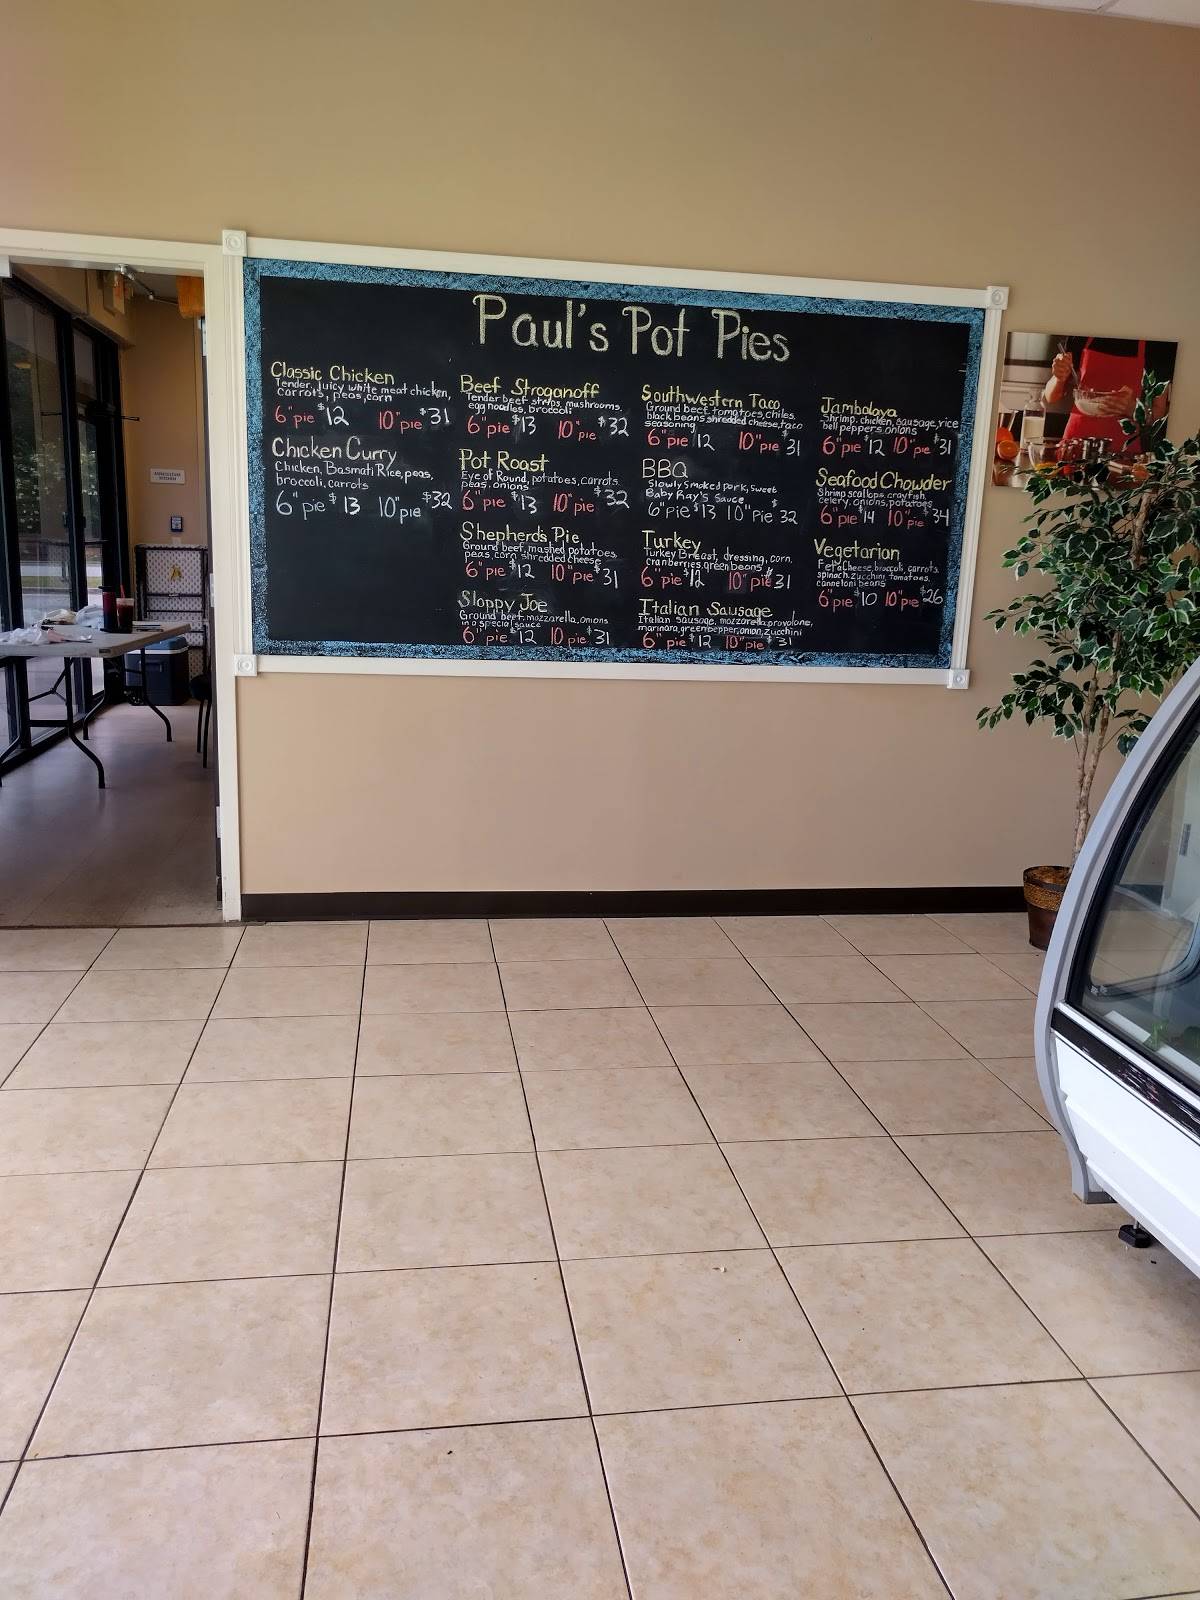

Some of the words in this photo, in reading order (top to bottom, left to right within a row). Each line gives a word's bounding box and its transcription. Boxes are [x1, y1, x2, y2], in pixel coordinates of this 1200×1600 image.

[472, 294, 608, 352] Paul's
[622, 305, 690, 357] Pot
[712, 308, 790, 362] Pies
[271, 362, 322, 381] Classic
[330, 366, 395, 385] Chicken
[348, 380, 377, 393] white
[381, 384, 408, 394] meat
[460, 375, 501, 394] Beef
[511, 378, 599, 400] Stroganoff
[466, 393, 498, 402] Tender
[503, 395, 528, 405] beef
[642, 385, 742, 408] Southwestern
[749, 394, 780, 409] Taco
[469, 402, 486, 414] egg
[646, 402, 680, 412] Ground
[821, 396, 897, 417] Jambalaya
[293, 414, 315, 428] pie
[400, 419, 422, 434] pie
[644, 421, 696, 433] seasoning
[647, 411, 671, 421] black
[780, 420, 803, 430] taco
[823, 422, 838, 430] bell
[938, 417, 958, 428] rice
[487, 423, 510, 438] pie
[578, 430, 597, 441] pie
[667, 436, 688, 448] pie
[760, 442, 779, 453] pie
[842, 443, 861, 458] pie
[914, 446, 931, 459] pie
[271, 437, 342, 458] Chicken
[347, 436, 396, 471] Curry
[459, 449, 491, 470] Pot
[498, 450, 549, 472] Roast
[324, 461, 374, 476] Basmati
[642, 458, 688, 478] BBQ
[461, 471, 479, 484] Eye
[483, 469, 493, 480] of
[816, 467, 878, 489] Seafood
[881, 471, 952, 491] Chowder
[328, 480, 368, 490] carrots
[494, 482, 528, 490] onions
[646, 489, 672, 500] Baby
[676, 490, 708, 503] Ray's
[715, 494, 744, 503] Sauce
[303, 498, 326, 520] pie
[400, 507, 421, 524] pie
[484, 497, 506, 511] pie
[574, 498, 594, 516] pie
[838, 514, 858, 528] pie
[551, 526, 579, 543] Pie
[463, 541, 498, 551] Ground
[529, 542, 565, 554] mashed
[642, 530, 701, 556] Turkey
[644, 548, 676, 558] Turkey
[814, 538, 900, 566] Vegetarian
[486, 566, 506, 580] pie
[573, 571, 594, 584] pie
[704, 562, 729, 573] green
[731, 563, 762, 571] beans
[661, 574, 682, 589] pie
[458, 590, 515, 613] Sloppy
[520, 593, 547, 612] Joe
[639, 599, 700, 616] Italian
[707, 602, 773, 618] Sausage
[834, 597, 853, 612] pie
[901, 598, 919, 611] pie
[460, 610, 496, 620] Ground
[580, 616, 608, 624] onions
[638, 616, 670, 624] Italian
[486, 630, 508, 646] pie
[764, 628, 802, 636] zucchini
[667, 637, 686, 650] pie
[746, 641, 764, 650] pie
